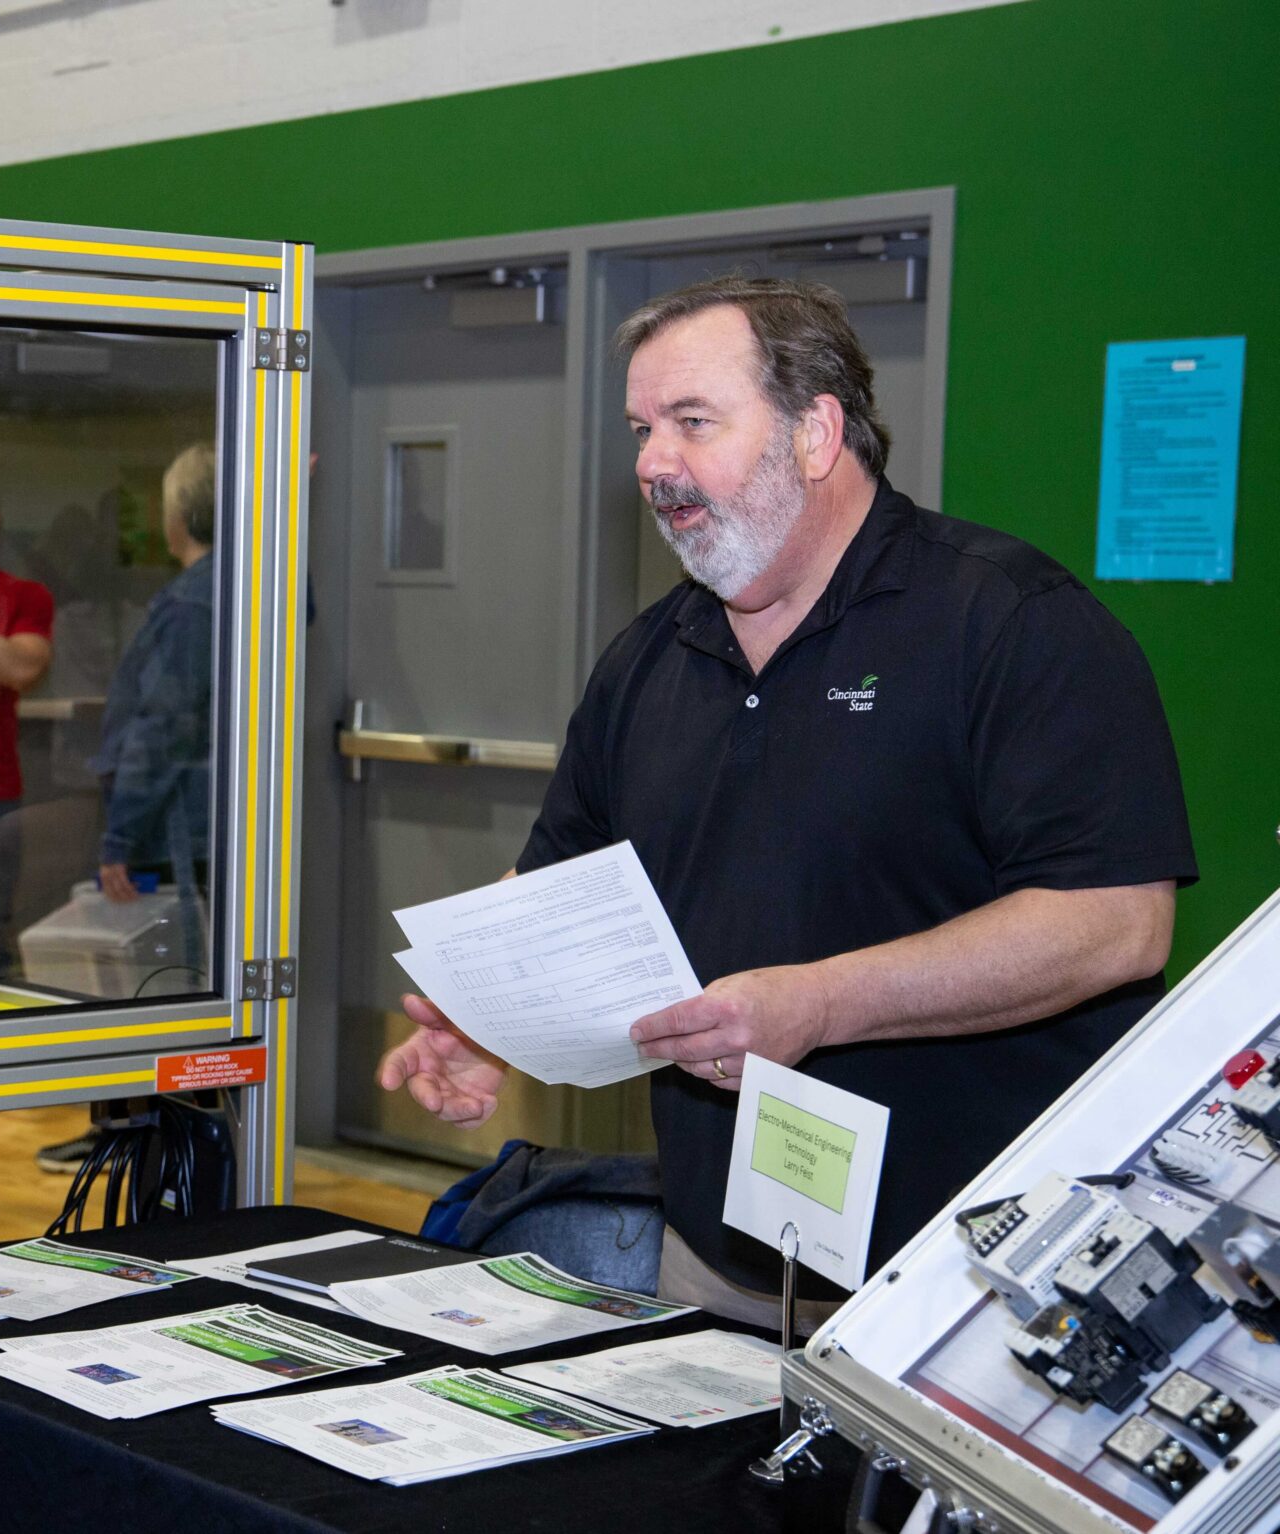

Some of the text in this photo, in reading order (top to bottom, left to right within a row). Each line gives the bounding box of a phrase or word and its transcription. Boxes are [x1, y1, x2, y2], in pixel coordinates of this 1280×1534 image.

[827, 687, 876, 701] Cincinnati
[849, 699, 873, 712] State
[195, 1053, 230, 1064] WARNING
[195, 1065, 207, 1073] NOT
[223, 1062, 238, 1070] ROCK
[171, 1074, 192, 1082] TIPPING
[201, 1071, 224, 1079] ROCKING
[179, 1081, 201, 1089] SERIOUS
[220, 1077, 229, 1085] OR
[758, 1109, 852, 1163] Electro-Mechanical Engineering
[784, 1138, 818, 1166] Technology
[783, 1157, 814, 1182] Larry Feist
